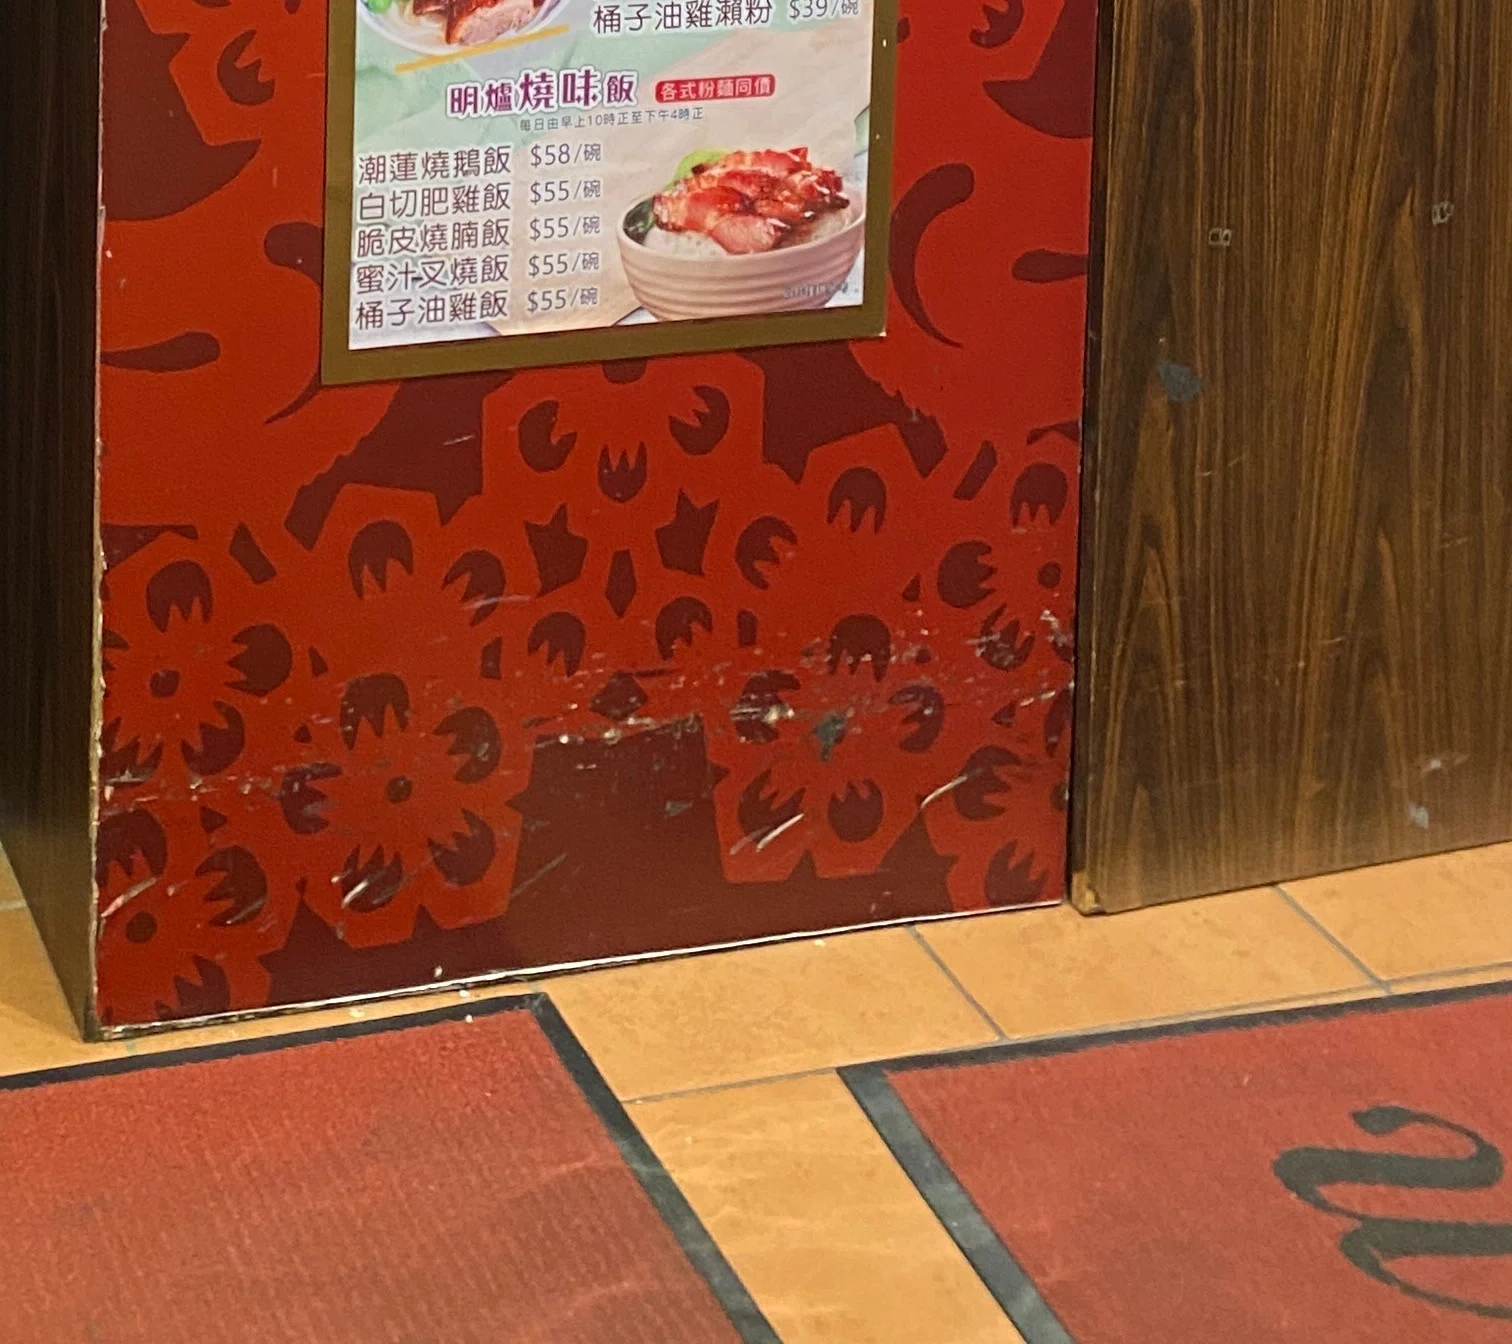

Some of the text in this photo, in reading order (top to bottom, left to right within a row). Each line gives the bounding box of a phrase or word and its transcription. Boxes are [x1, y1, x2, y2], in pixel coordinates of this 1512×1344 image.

[449, 69, 637, 116] 明爐燒味飯
[660, 76, 773, 102] 各式粉麵同價
[519, 106, 704, 132] 每日由早上10時正至下午4時正
[358, 142, 601, 185] 潮蓮燒鵝飯 $58/碗
[358, 178, 601, 222] 白切肥雞飯 $55/碗
[357, 215, 601, 258] 脆皮燒腩飯 $55/碗
[356, 251, 600, 295] 蜜汁叉燒飯 $55/碗
[355, 287, 599, 331] 桶子油雞飯 $55/碗
